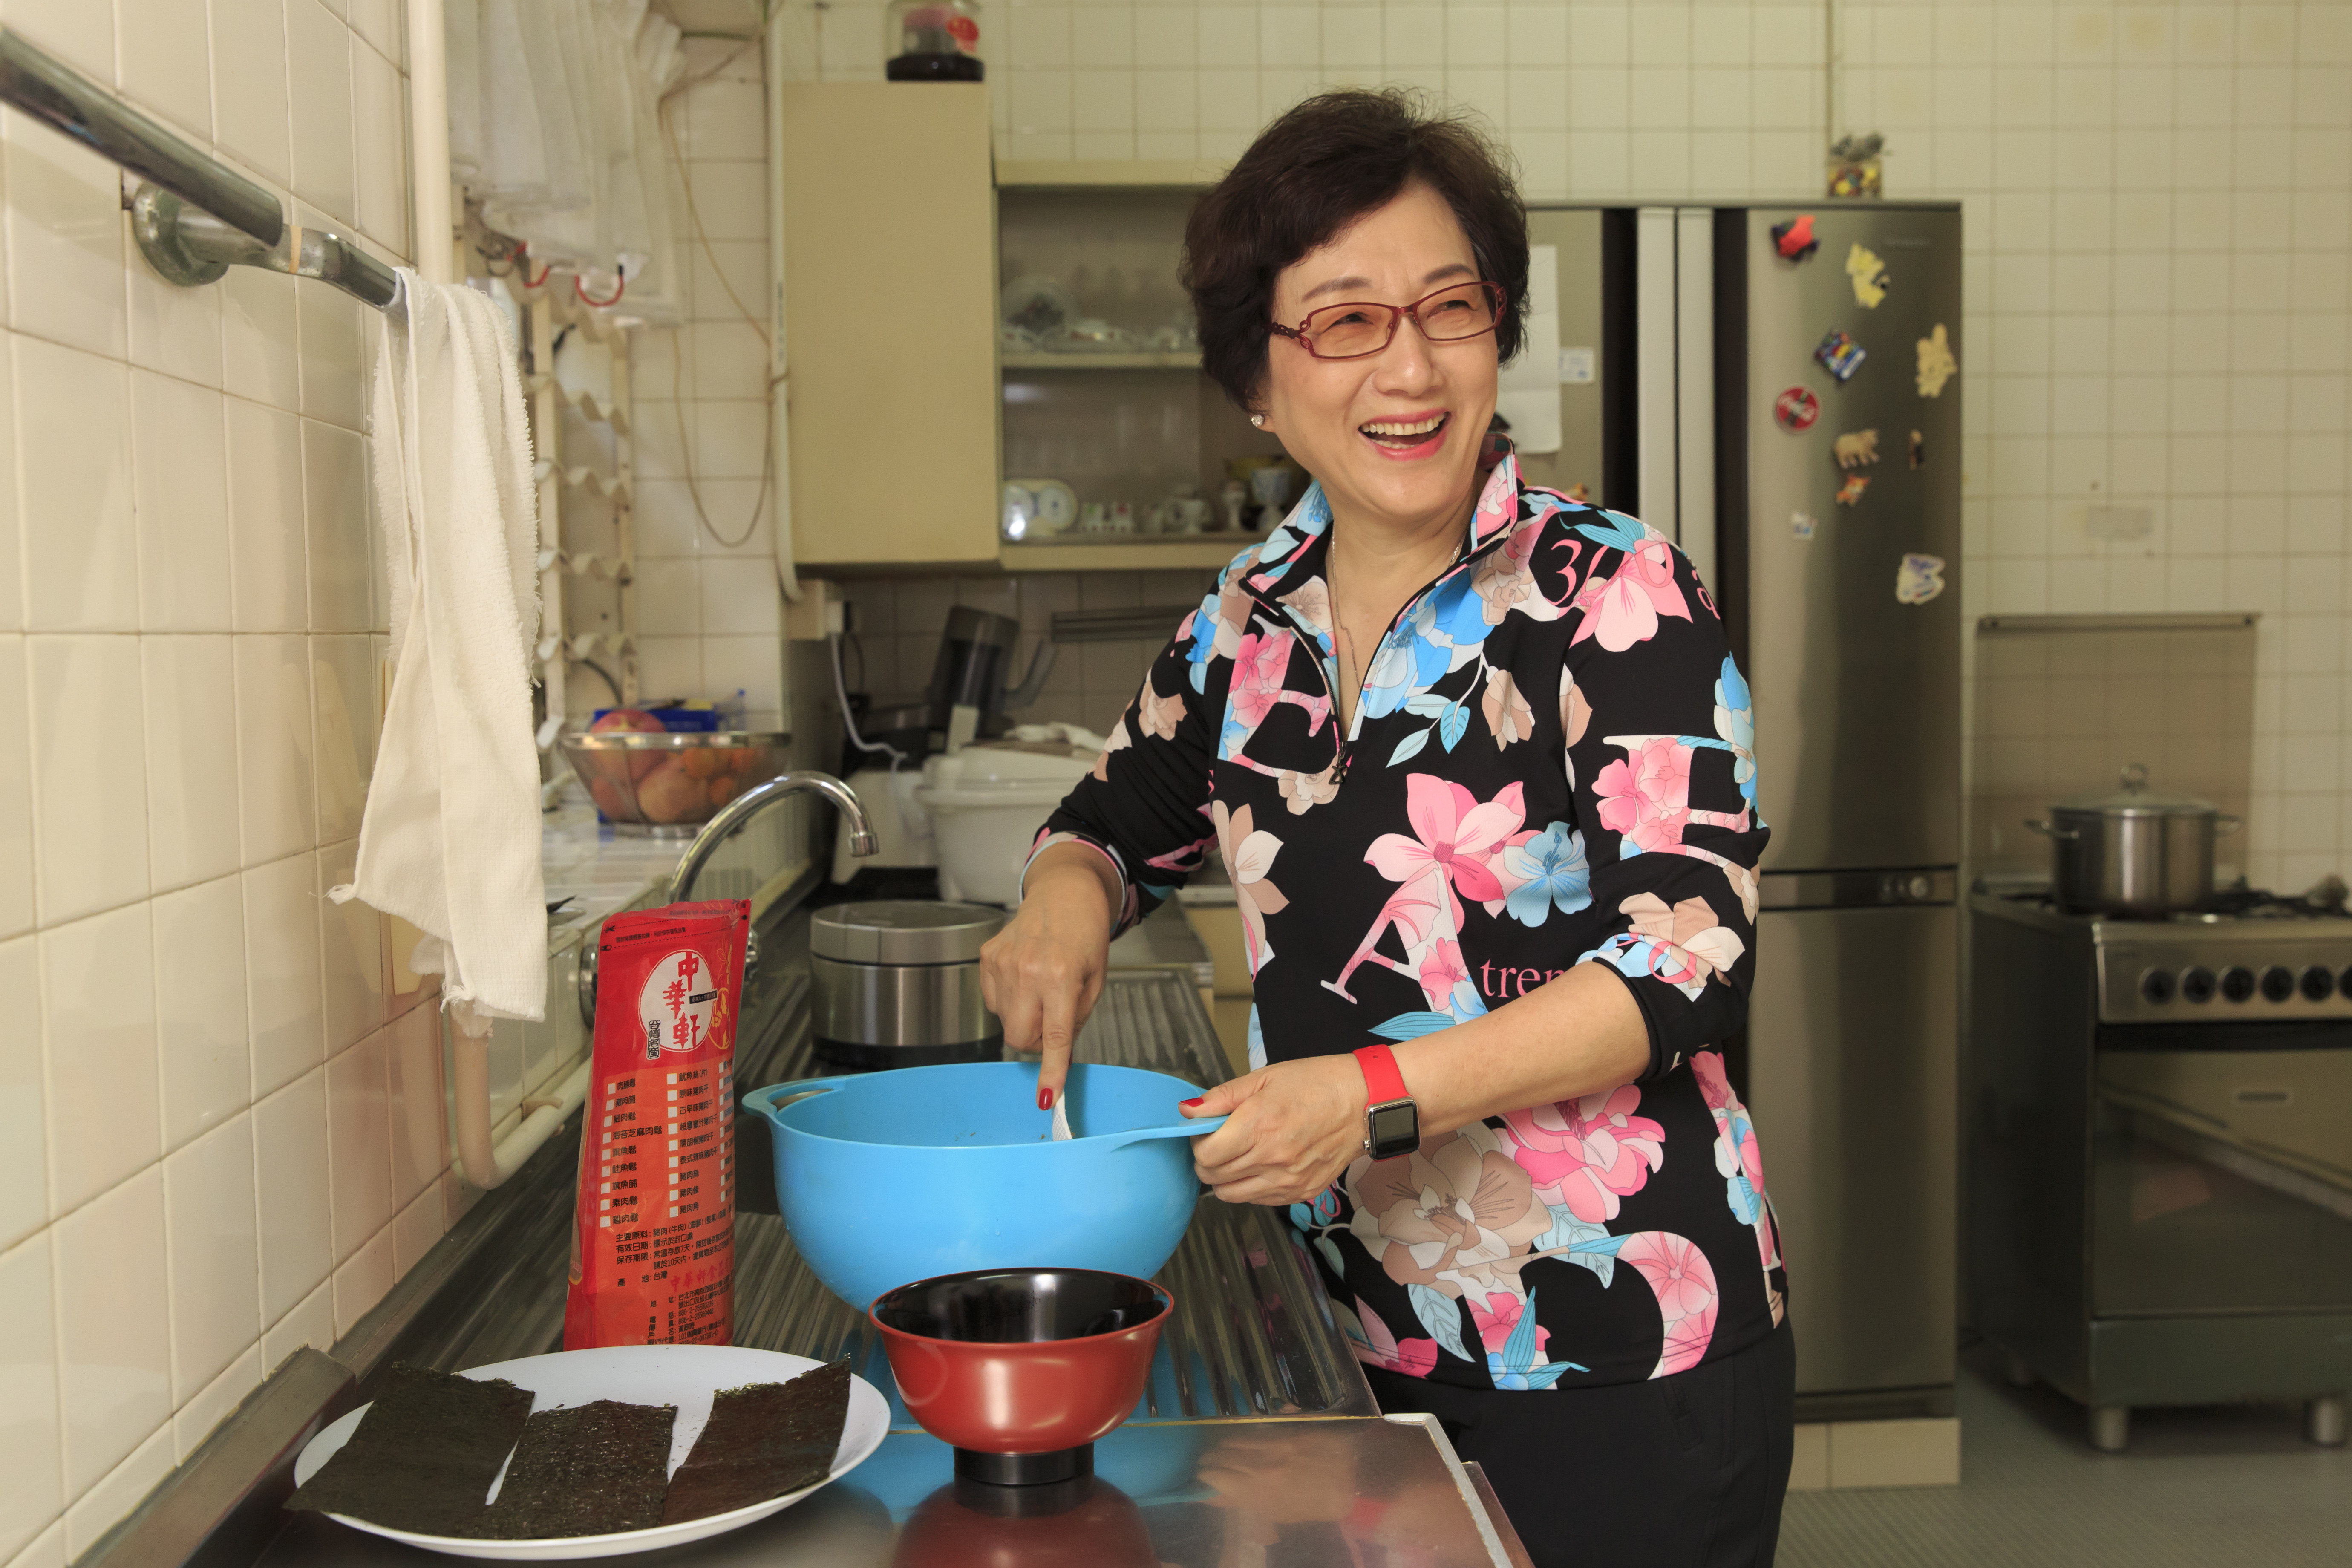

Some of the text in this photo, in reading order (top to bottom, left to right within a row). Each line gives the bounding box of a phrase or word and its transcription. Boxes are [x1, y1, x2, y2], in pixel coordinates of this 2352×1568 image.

[663, 951, 701, 1049] 中華軒
[613, 1125, 662, 1140] 海苔芝麻肉鬆
[612, 1196, 638, 1208] 素肉鬆
